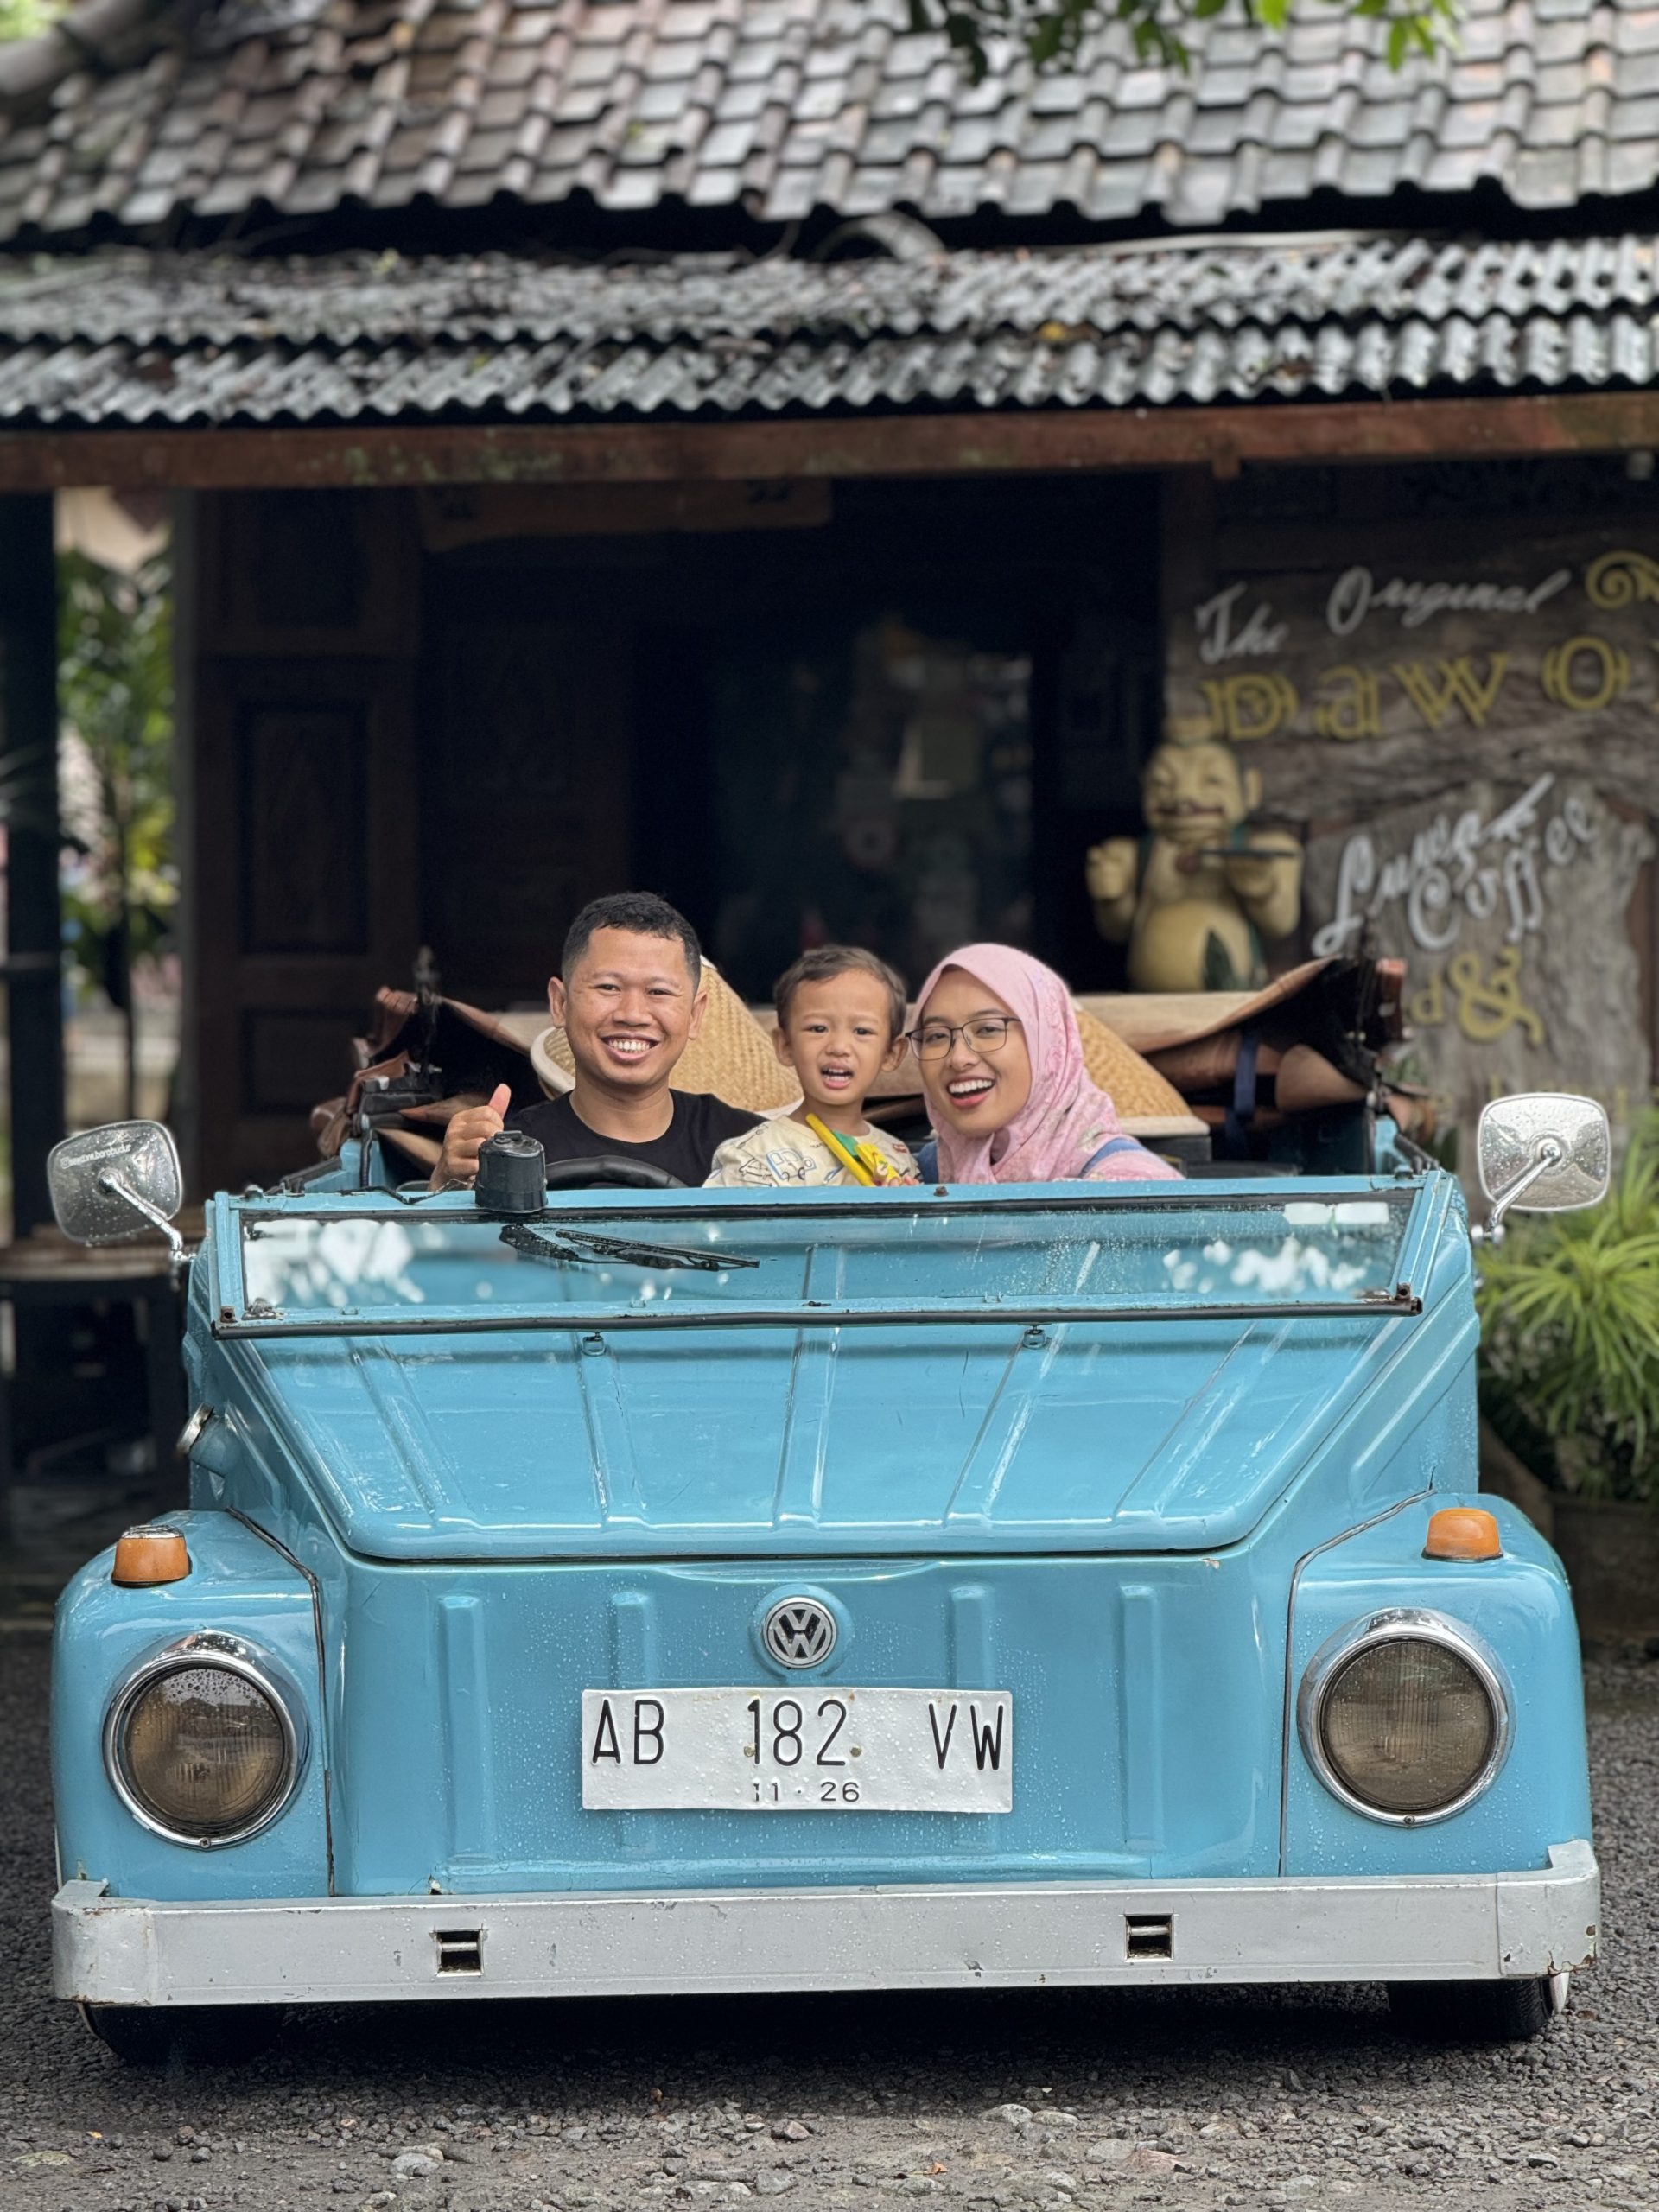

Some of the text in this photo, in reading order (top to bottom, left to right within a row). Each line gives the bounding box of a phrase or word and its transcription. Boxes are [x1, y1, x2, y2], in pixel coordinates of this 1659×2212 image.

[1195, 581, 1288, 664] The
[1447, 945, 1544, 1046] &
[592, 1699, 1004, 1770] AB 182 VW
